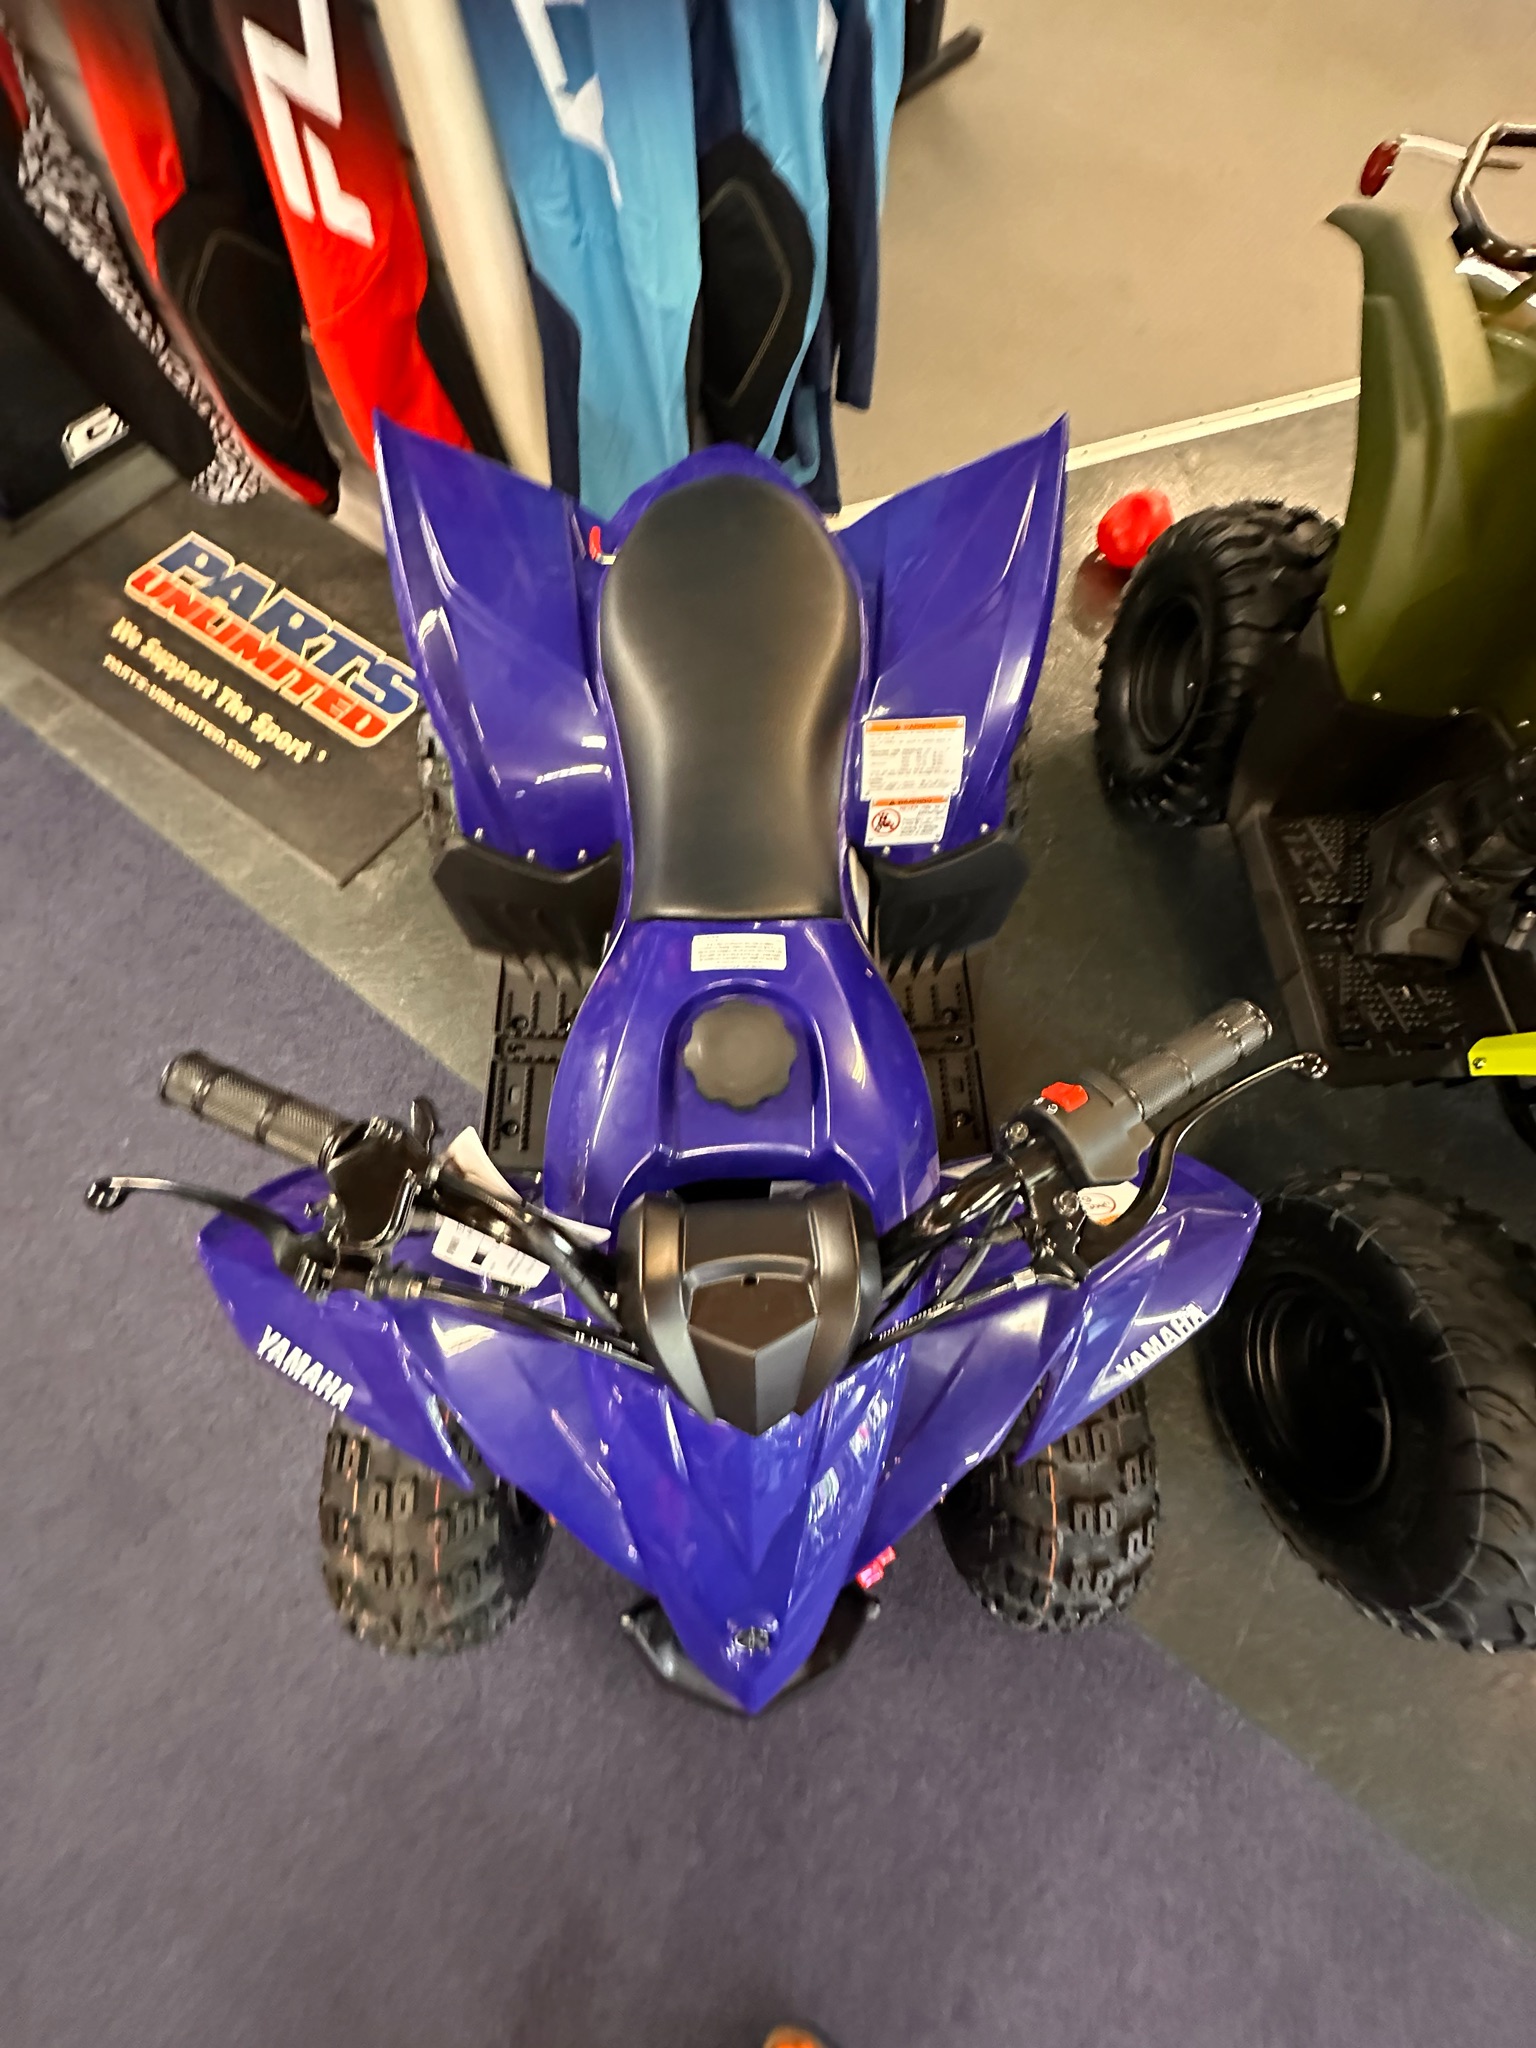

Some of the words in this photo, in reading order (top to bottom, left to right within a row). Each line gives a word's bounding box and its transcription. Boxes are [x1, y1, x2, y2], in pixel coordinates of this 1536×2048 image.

[127, 564, 392, 743] UNLIMITED
[154, 533, 419, 716] PARTS
[138, 637, 219, 701] Support
[215, 685, 253, 724] The
[256, 1324, 354, 1412] YAMAHA
[1114, 1302, 1208, 1380] YAMAHA
